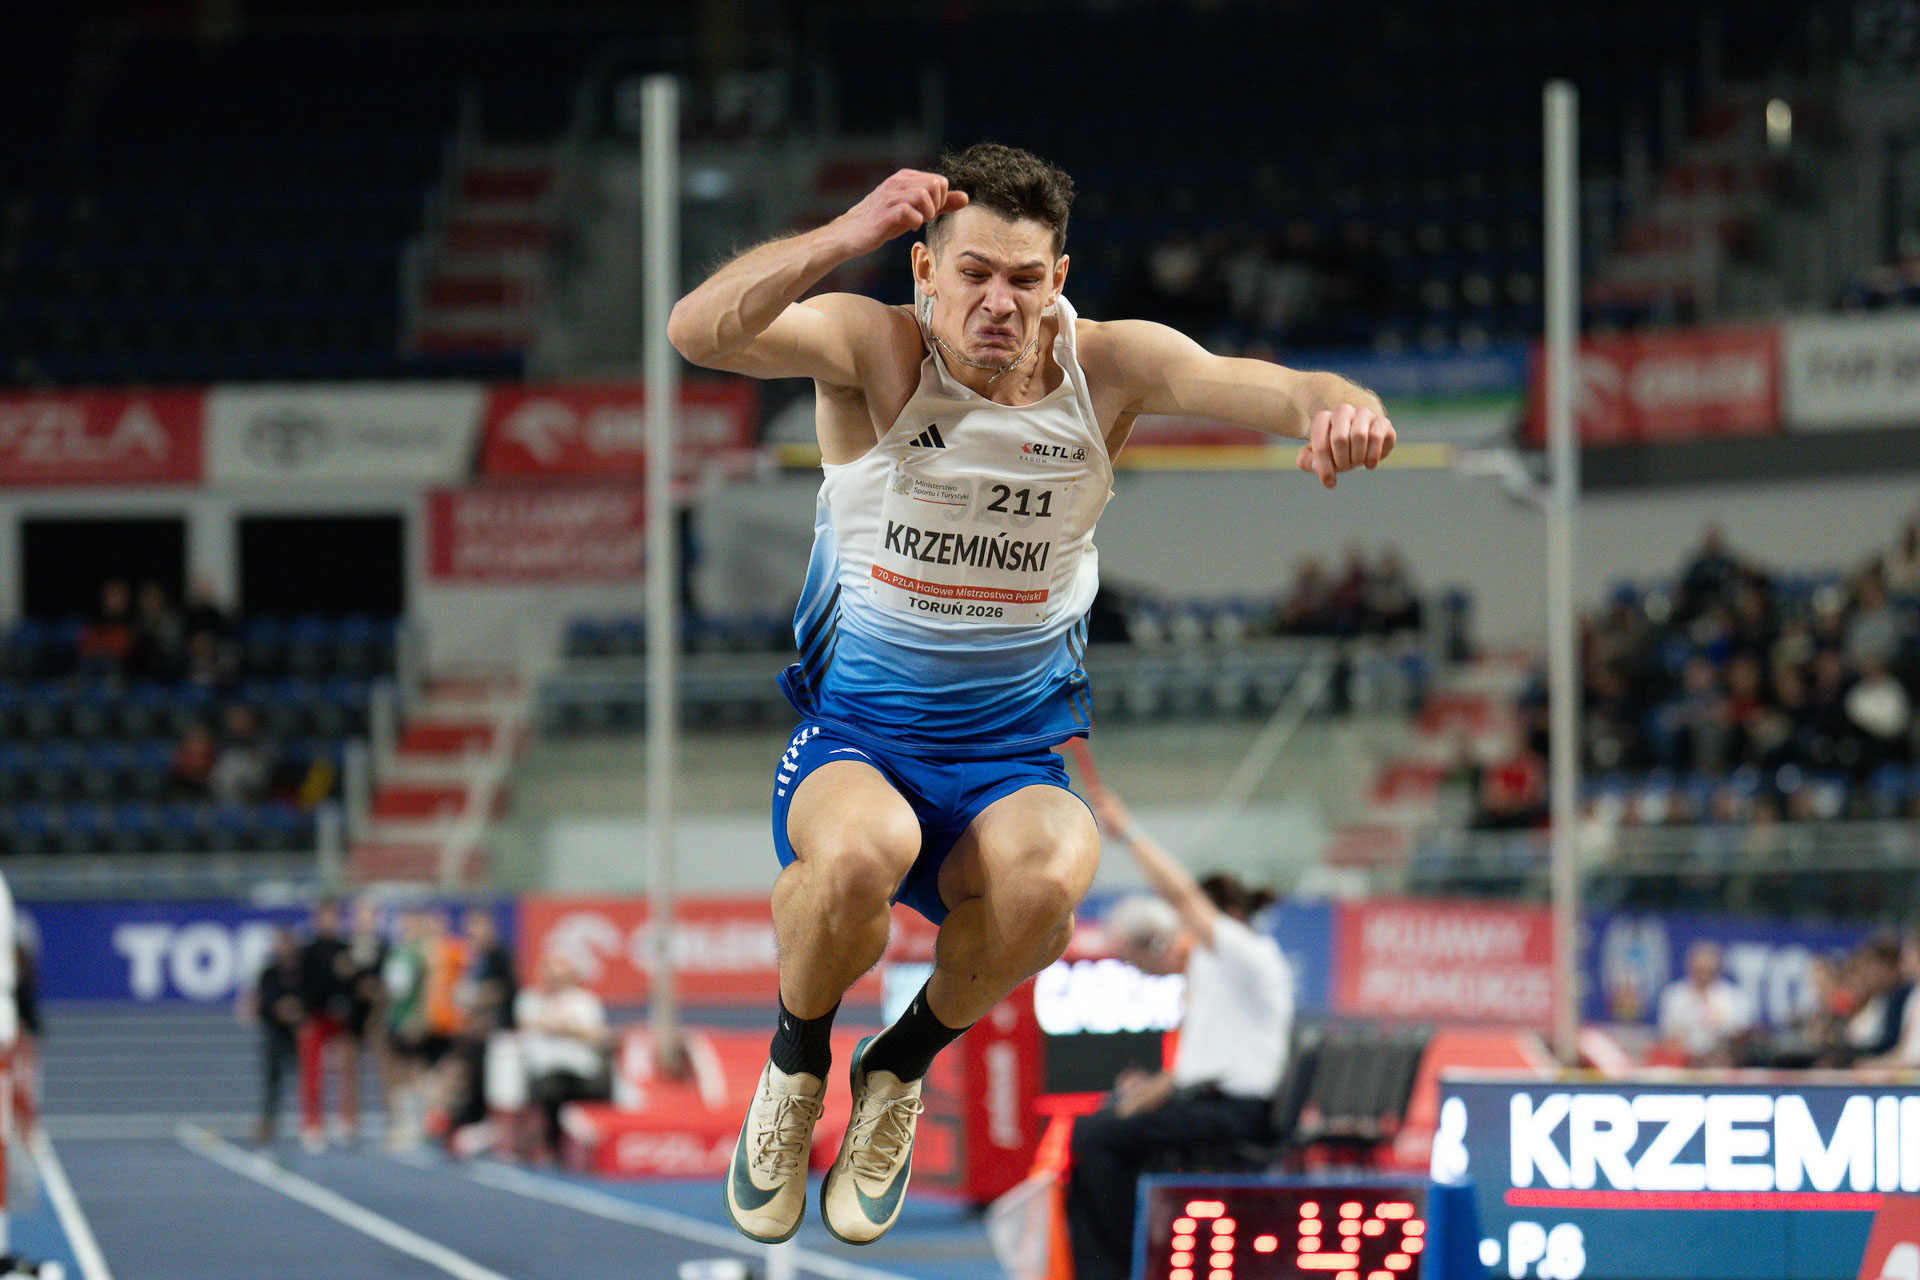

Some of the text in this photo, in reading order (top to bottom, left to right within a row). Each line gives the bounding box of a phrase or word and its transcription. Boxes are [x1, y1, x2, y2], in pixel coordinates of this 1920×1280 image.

[1032, 443, 1068, 459] RLTL
[914, 486, 936, 497] Sportu
[941, 491, 970, 501] Turystyki
[915, 479, 958, 492] Ministerstwo
[987, 484, 1052, 517] 211
[884, 520, 1050, 572] KRZEMIŃSKI
[877, 568, 1042, 601] 70. PZLA Halowe Mistrzostwa Polski
[908, 596, 1004, 618] TORUŃ 2026
